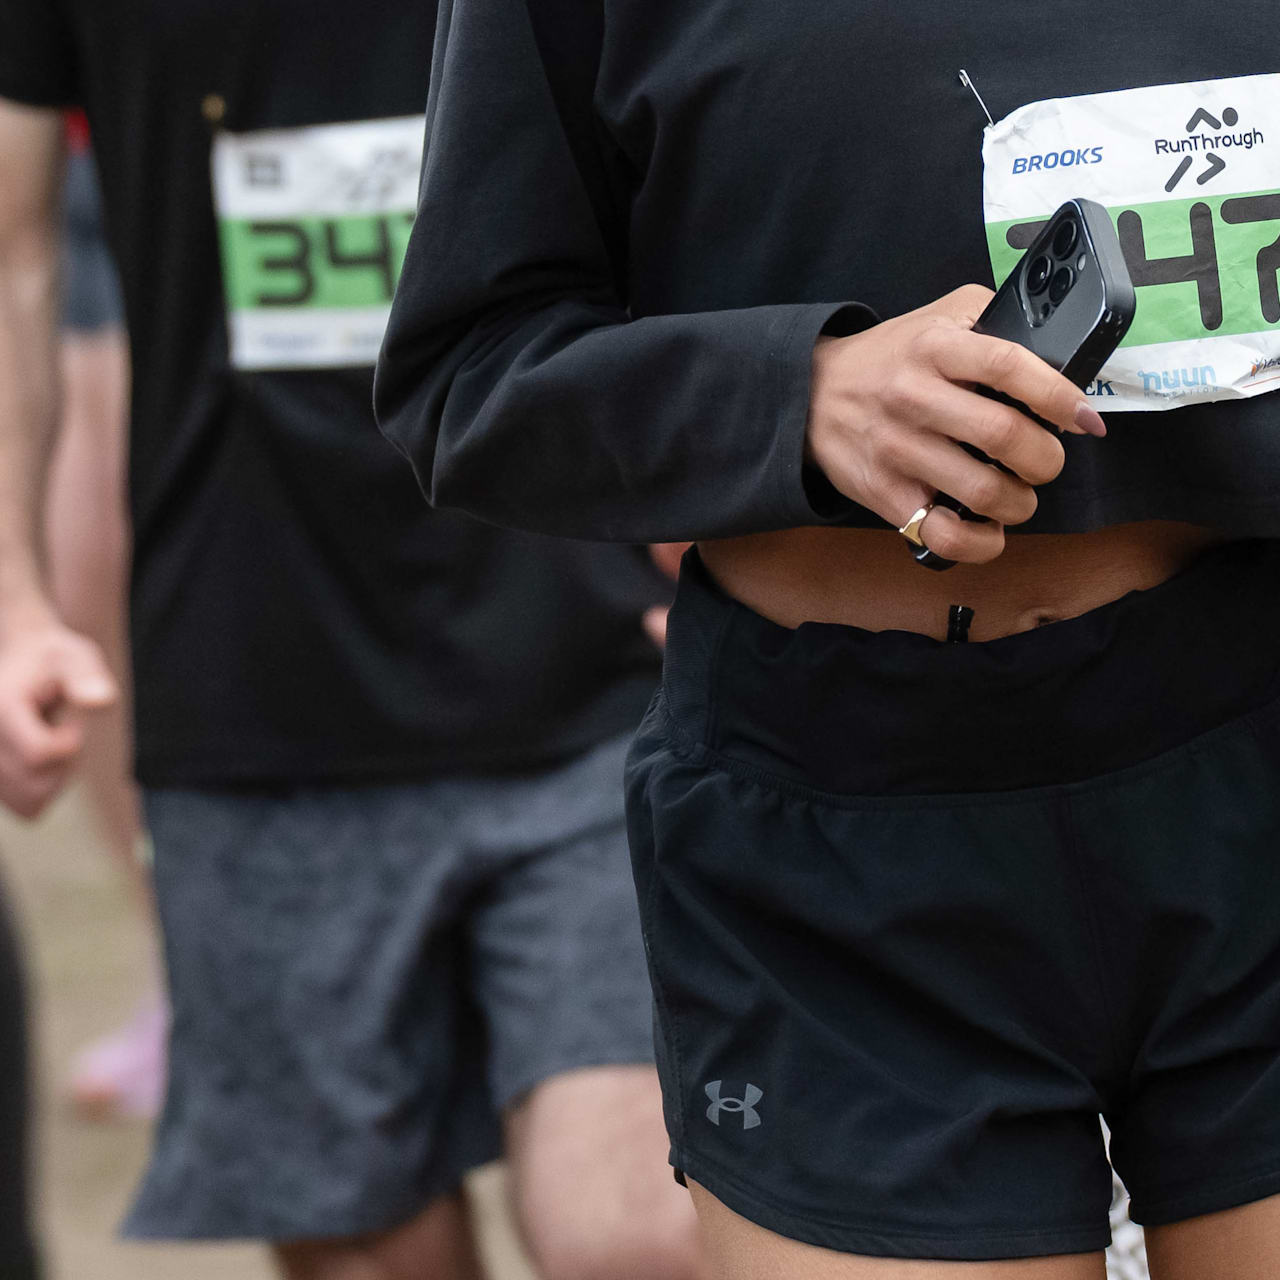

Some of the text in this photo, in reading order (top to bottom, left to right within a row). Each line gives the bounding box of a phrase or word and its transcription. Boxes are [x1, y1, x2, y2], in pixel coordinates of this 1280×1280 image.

[1154, 128, 1265, 155] RunThrough
[1012, 146, 1104, 175] BROOKS
[248, 213, 419, 307] 34
[1137, 365, 1217, 391] nuun
